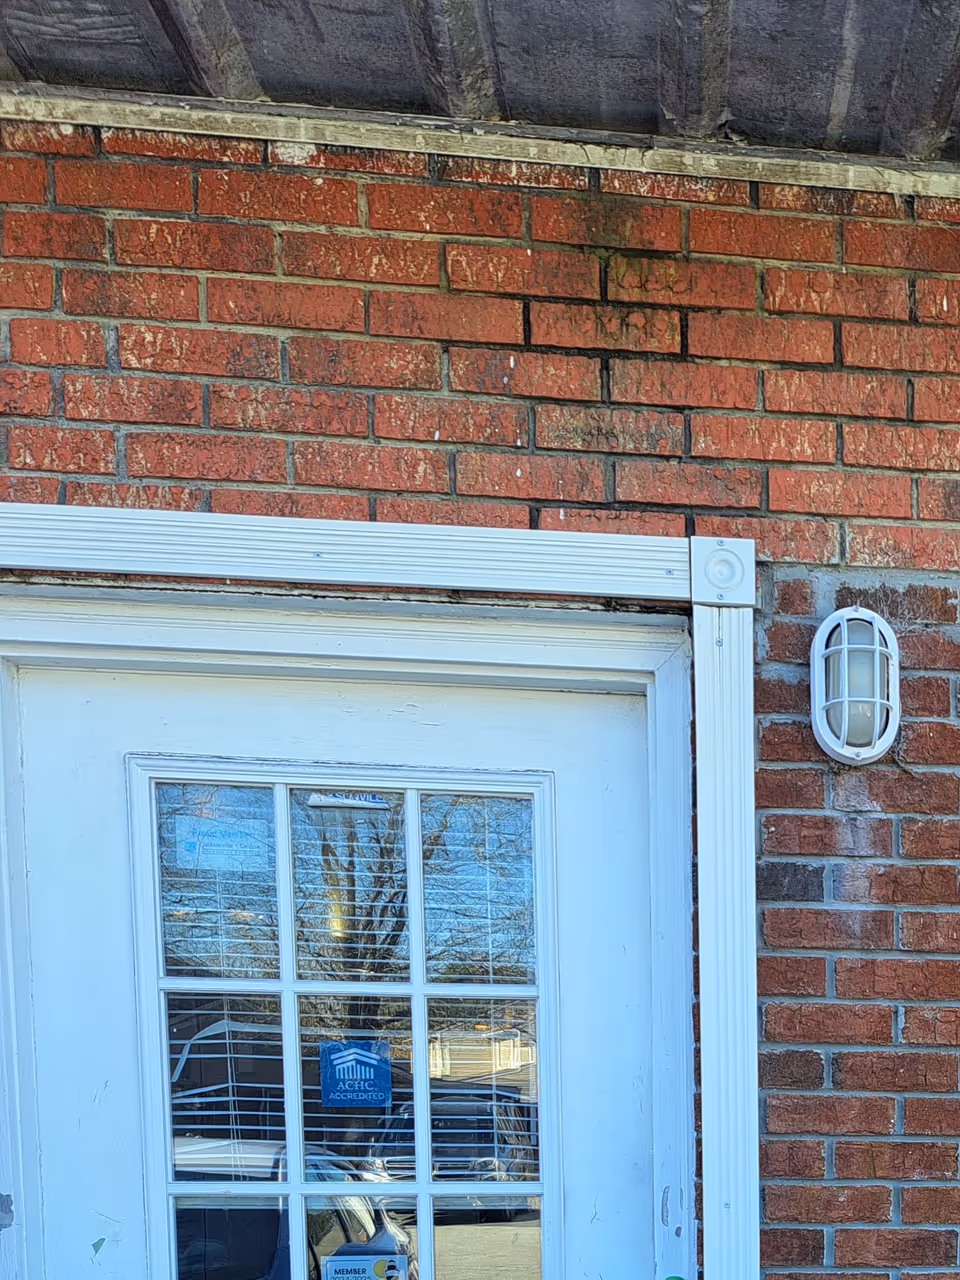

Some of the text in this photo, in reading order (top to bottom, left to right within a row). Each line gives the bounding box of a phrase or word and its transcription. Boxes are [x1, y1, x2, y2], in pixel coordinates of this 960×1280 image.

[336, 1080, 374, 1090] ACHC
[328, 1092, 385, 1100] ACCREDITED
[333, 1267, 367, 1275] MEMBER
